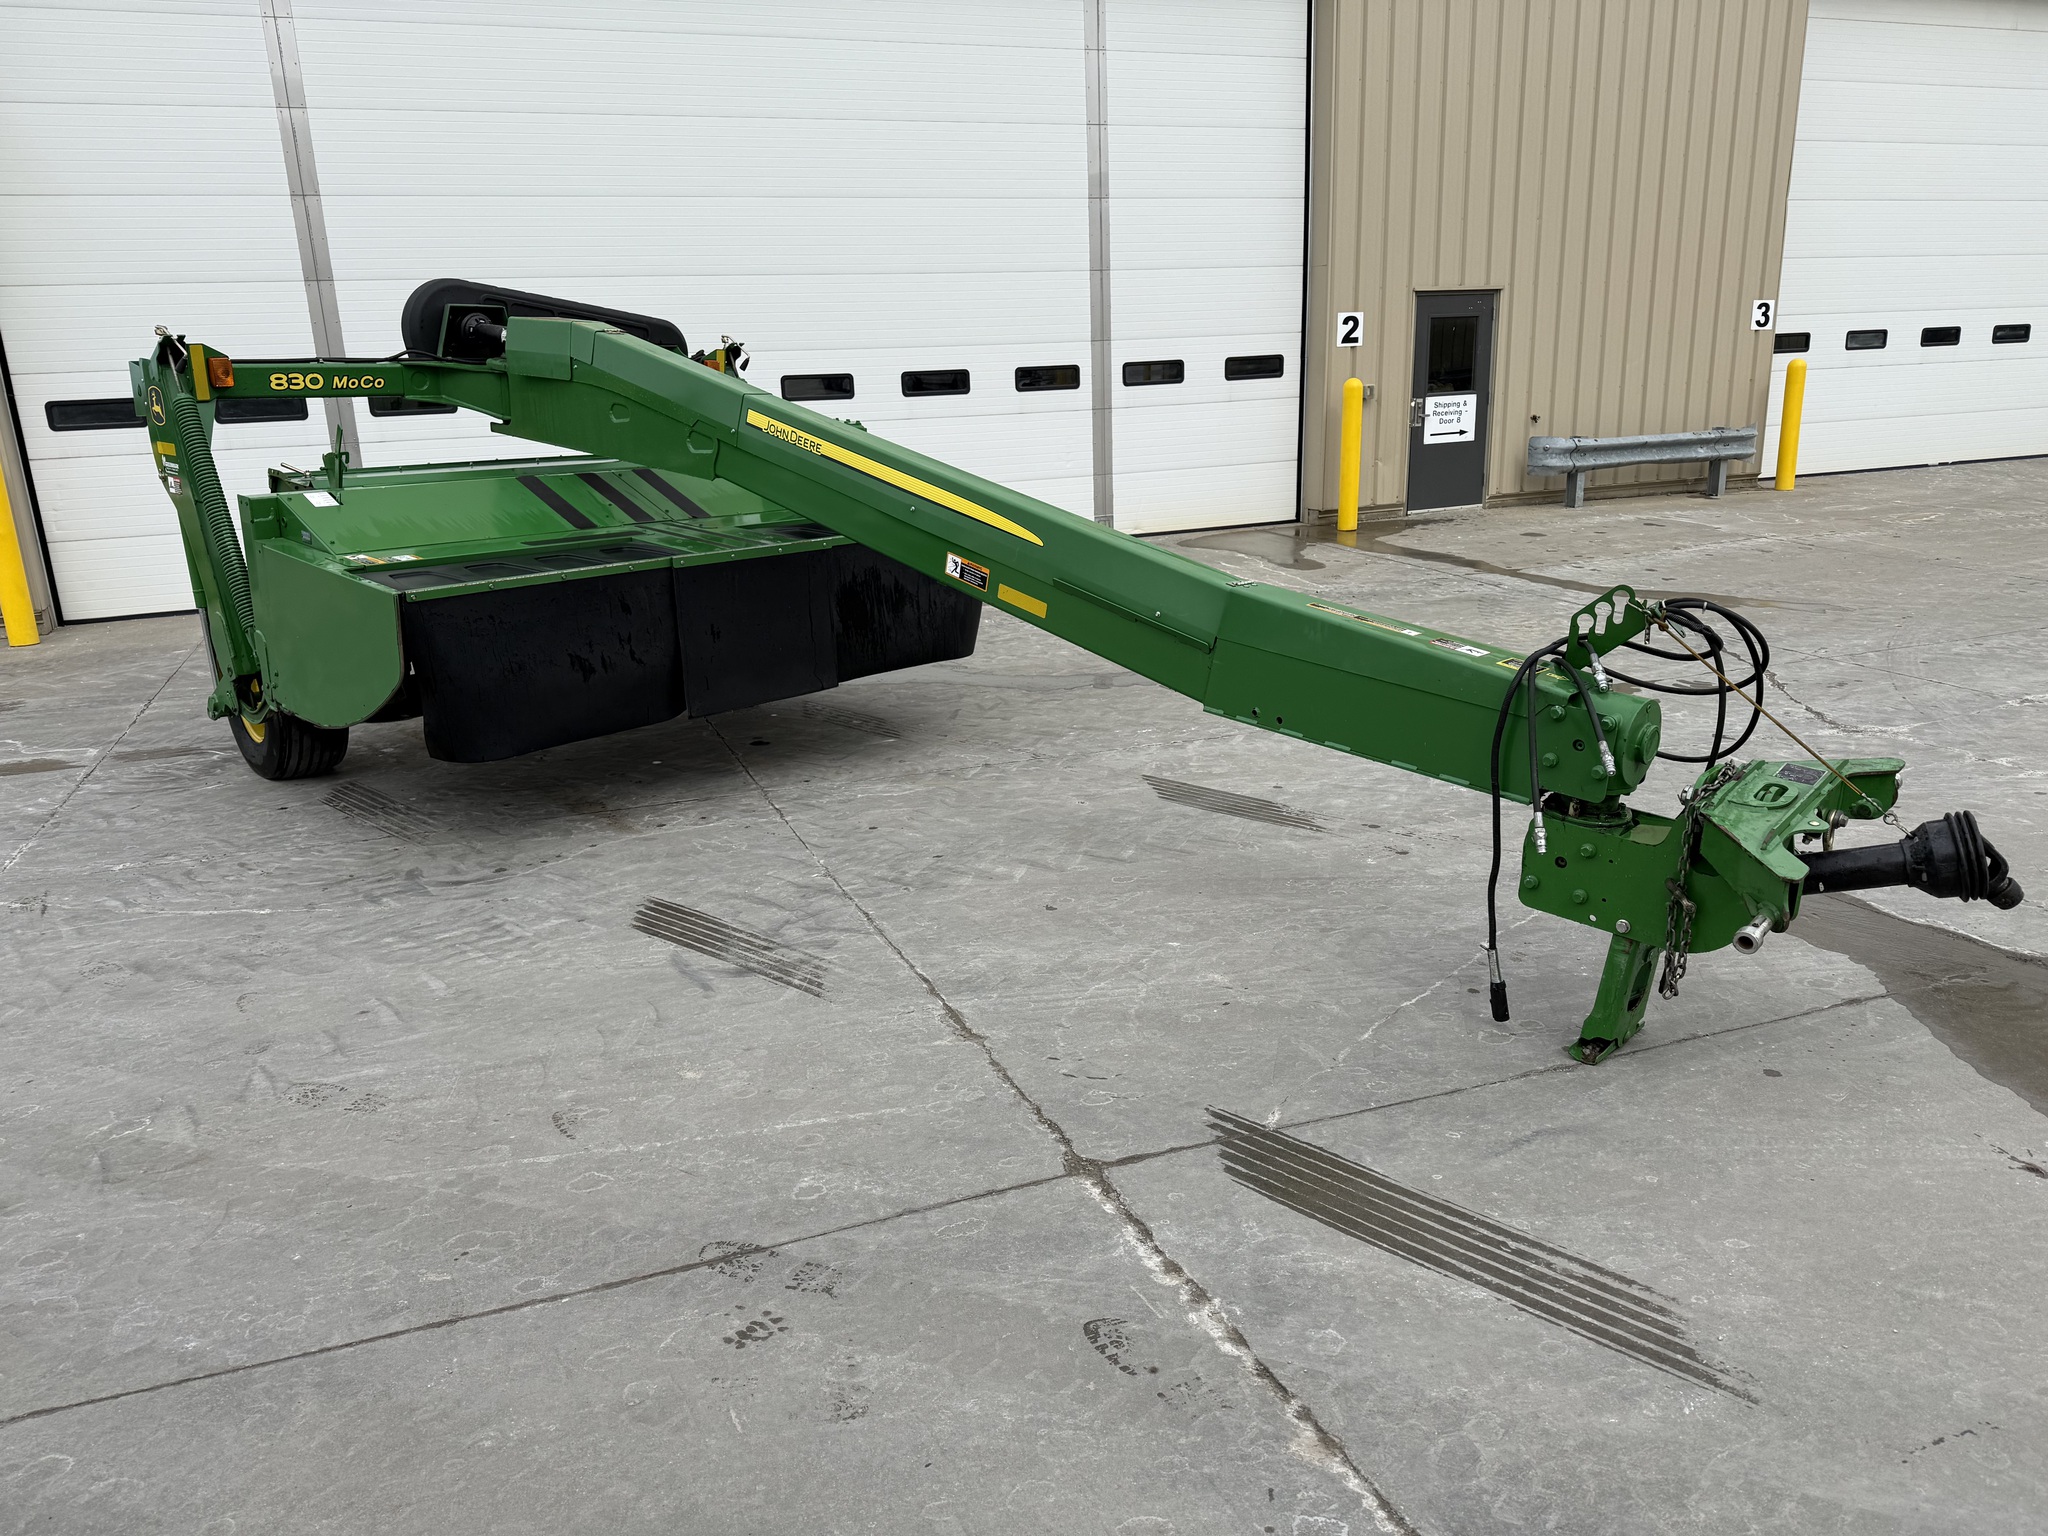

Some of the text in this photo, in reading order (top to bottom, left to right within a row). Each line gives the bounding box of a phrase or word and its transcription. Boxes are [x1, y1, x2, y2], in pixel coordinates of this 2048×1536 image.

[1755, 302, 1771, 328] 3
[1341, 315, 1360, 344] 2
[269, 372, 385, 391] 830 MoCo
[763, 420, 822, 454] JOHN DEERE
